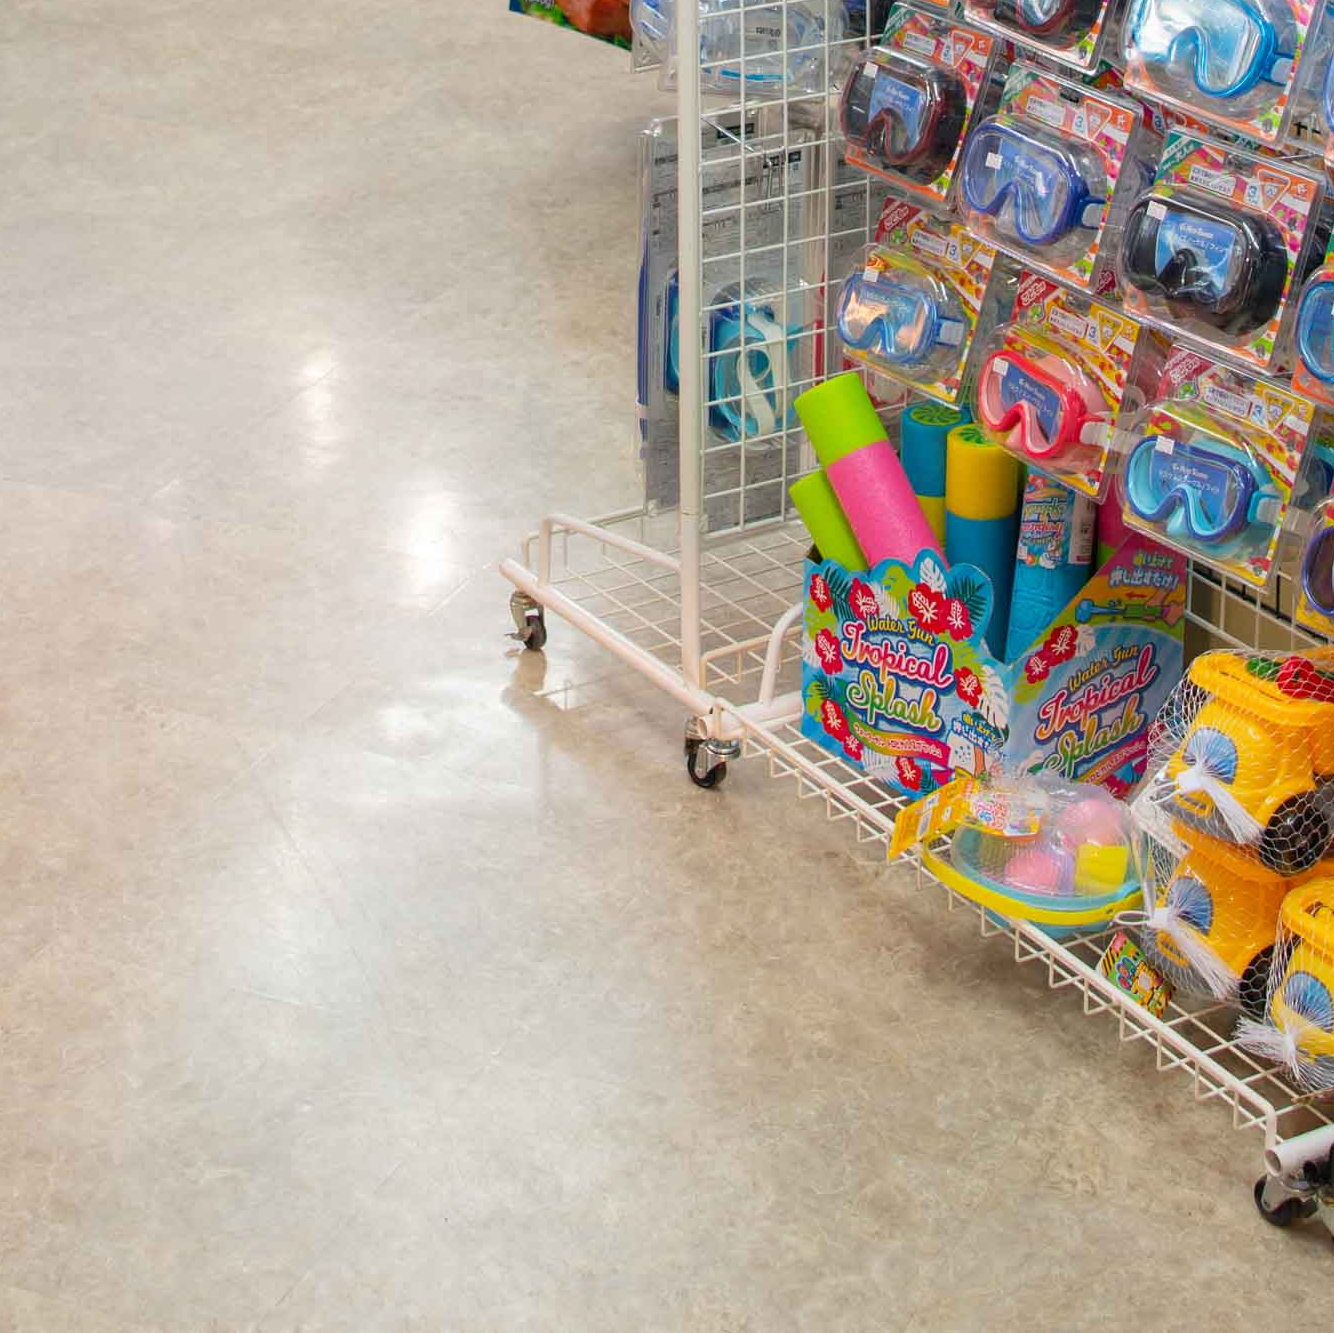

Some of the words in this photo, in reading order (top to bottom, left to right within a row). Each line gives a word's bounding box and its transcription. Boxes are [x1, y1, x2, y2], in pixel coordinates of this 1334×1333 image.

[841, 619, 955, 688] Tropical
[866, 614, 905, 639] Water
[907, 618, 935, 648] Gun
[1111, 644, 1140, 667] Gun
[846, 671, 942, 731] Splash
[1038, 641, 1158, 735] Tropical
[1046, 698, 1147, 777] Splash
